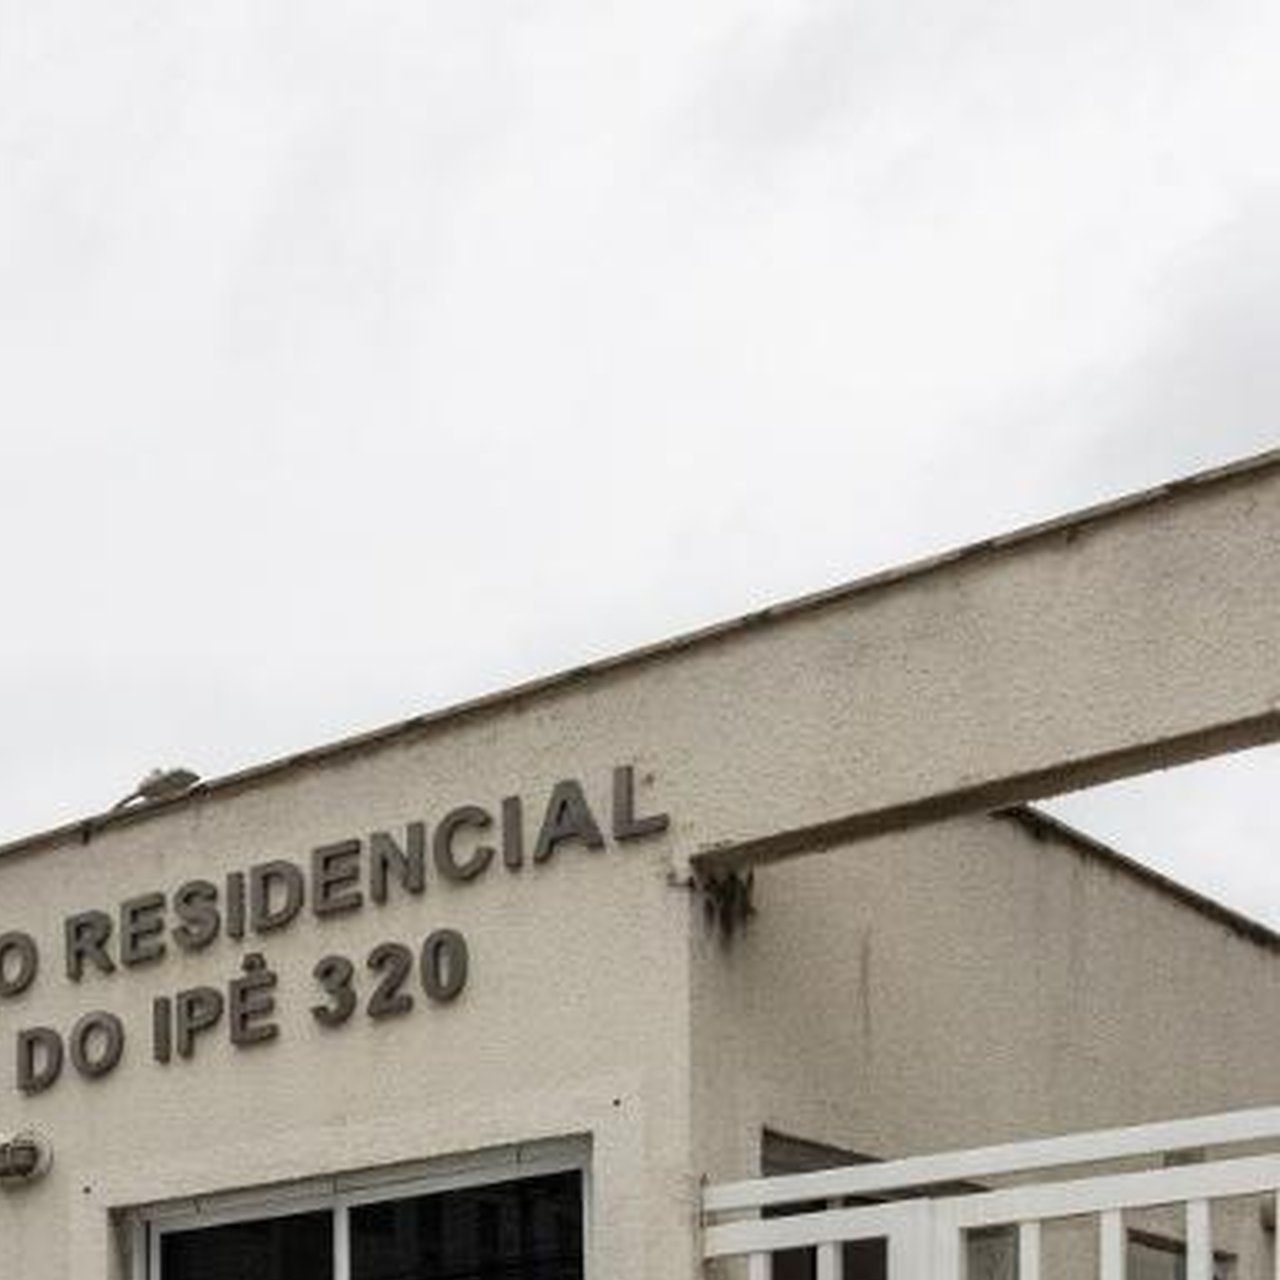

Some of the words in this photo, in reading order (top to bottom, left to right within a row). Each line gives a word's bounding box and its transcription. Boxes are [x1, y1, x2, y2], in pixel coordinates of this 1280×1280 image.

[65, 765, 668, 981] RESIDENCIAL
[16, 1011, 125, 1096] DO
[152, 953, 279, 1063] IPÊ
[311, 928, 470, 1027] 320
